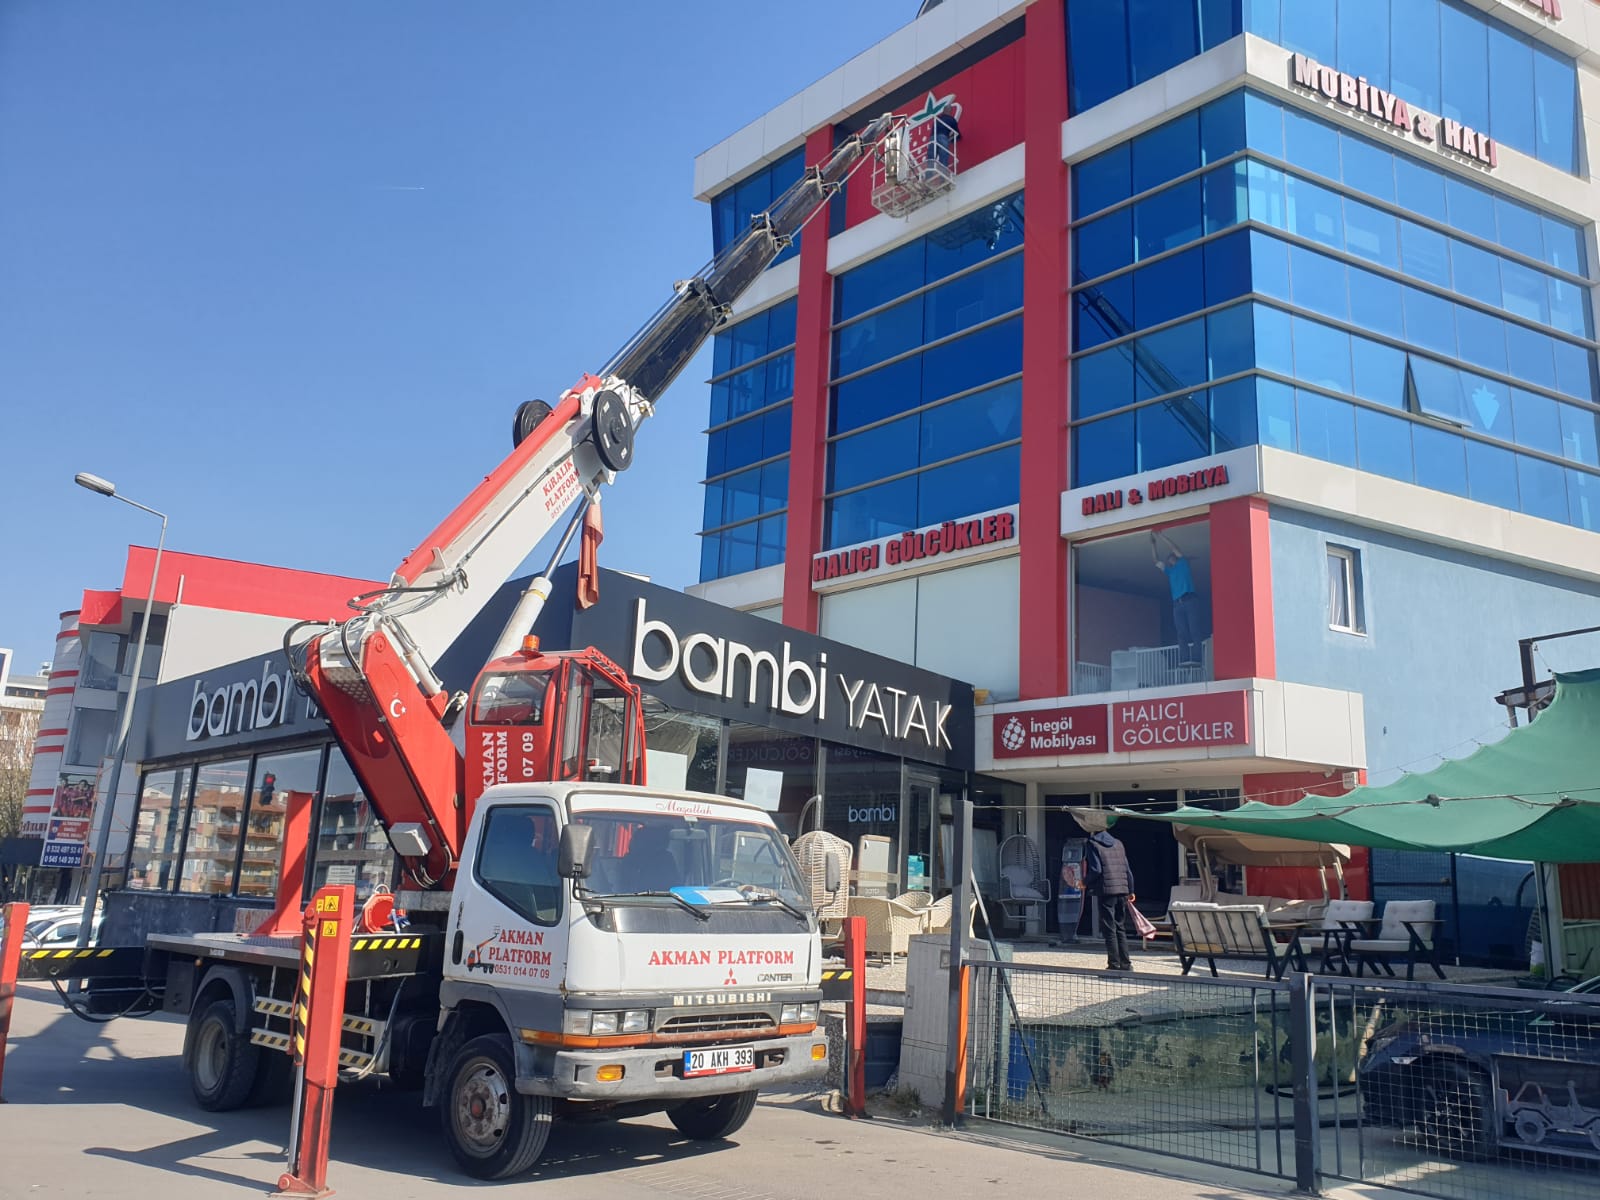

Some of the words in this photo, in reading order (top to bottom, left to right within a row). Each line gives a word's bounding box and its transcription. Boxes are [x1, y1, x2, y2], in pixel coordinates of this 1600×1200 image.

[1415, 113, 1435, 144] &
[1440, 117, 1498, 169] HALI
[1082, 489, 1122, 517] HALI
[1127, 488, 1143, 506] &
[813, 543, 880, 582] HALICI
[885, 511, 1014, 566] GÖLCÜKLER
[633, 597, 828, 720] bambi
[836, 673, 953, 751] YATAK
[1122, 702, 1185, 724] HALICI
[1030, 716, 1073, 734] İnegöl
[1122, 720, 1235, 746] GÖLCÜKLER
[522, 732, 534, 753] 09
[1030, 733, 1097, 751] Mobilyası
[482, 731, 495, 790] KMAN
[522, 757, 534, 777] 07
[848, 803, 896, 822] bambi
[498, 928, 544, 945] AKMAN
[488, 946, 552, 966] PLATFORM
[648, 950, 711, 966] AKMAN
[718, 950, 794, 964] PLATFORM
[494, 964, 511, 976] 0531
[513, 965, 527, 976] 014
[528, 967, 539, 978] 07
[539, 968, 551, 979] 09
[757, 973, 793, 982] CANTER
[673, 992, 772, 1006] MITSUBISHI
[691, 1053, 705, 1069] 20
[710, 1051, 729, 1067] AKH
[734, 1049, 753, 1065] 393
